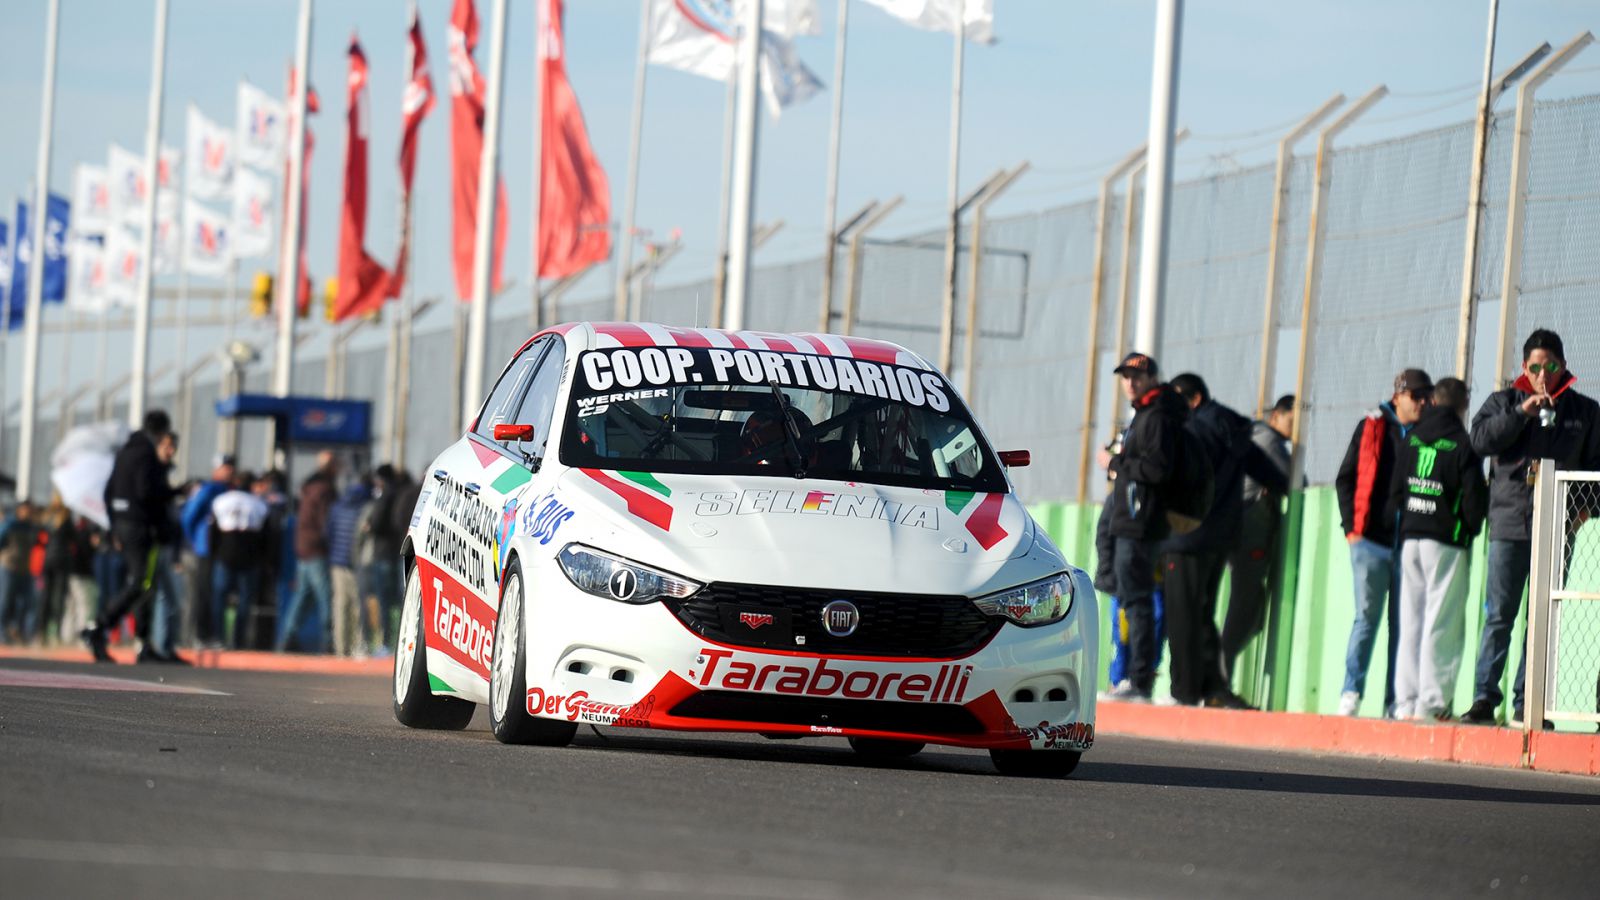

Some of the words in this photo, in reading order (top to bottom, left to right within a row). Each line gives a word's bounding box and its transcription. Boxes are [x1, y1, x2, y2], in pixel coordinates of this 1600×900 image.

[577, 389, 668, 408] WERNER
[582, 348, 703, 391] COOP.
[708, 349, 950, 413] PORTUARIOS
[460, 491, 498, 550] TRABAJOS
[696, 489, 939, 530] SELENIA
[425, 516, 467, 579] PORTUARIOS
[616, 570, 628, 597] 1
[433, 577, 497, 671] Tarabore
[740, 612, 773, 629] RIVA
[831, 610, 852, 627] FIAT
[700, 648, 972, 703] Taraborelli
[581, 713, 651, 728] NEUMATICOS
